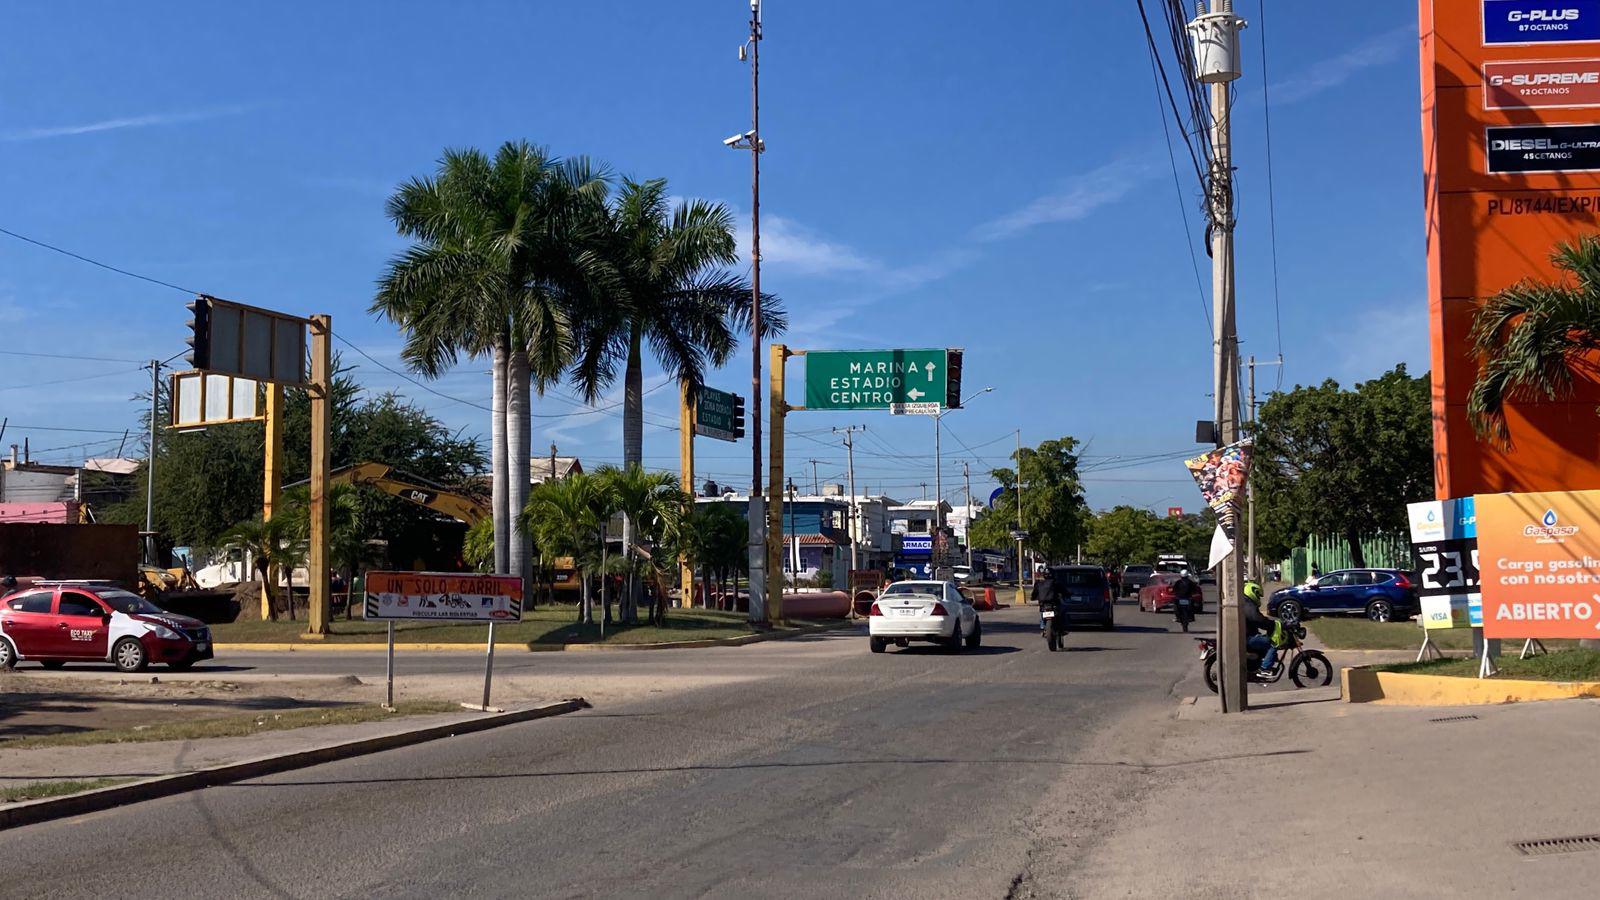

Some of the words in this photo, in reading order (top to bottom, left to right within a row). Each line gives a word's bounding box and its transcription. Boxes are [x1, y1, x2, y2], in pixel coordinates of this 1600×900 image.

[1508, 9, 1579, 22] G-PLUS
[1530, 23, 1569, 31] OCTANOS
[1490, 72, 1600, 86] G-SUPREME
[1491, 139, 1558, 151] DIESEL
[1535, 152, 1573, 160] CETANOS
[850, 361, 918, 374] MARINA
[830, 377, 900, 389] ESTADIO
[830, 392, 893, 403] CENTRO
[411, 490, 428, 504] CAT
[1524, 525, 1576, 538] Gaspasa
[1497, 558, 1543, 572] Carga
[1500, 574, 1529, 584] con
[388, 579, 403, 593] UN
[415, 579, 446, 594] SOLO
[459, 580, 504, 595] CARRIL
[1430, 612, 1447, 620] VISA
[1496, 602, 1592, 620] ABIERTO
